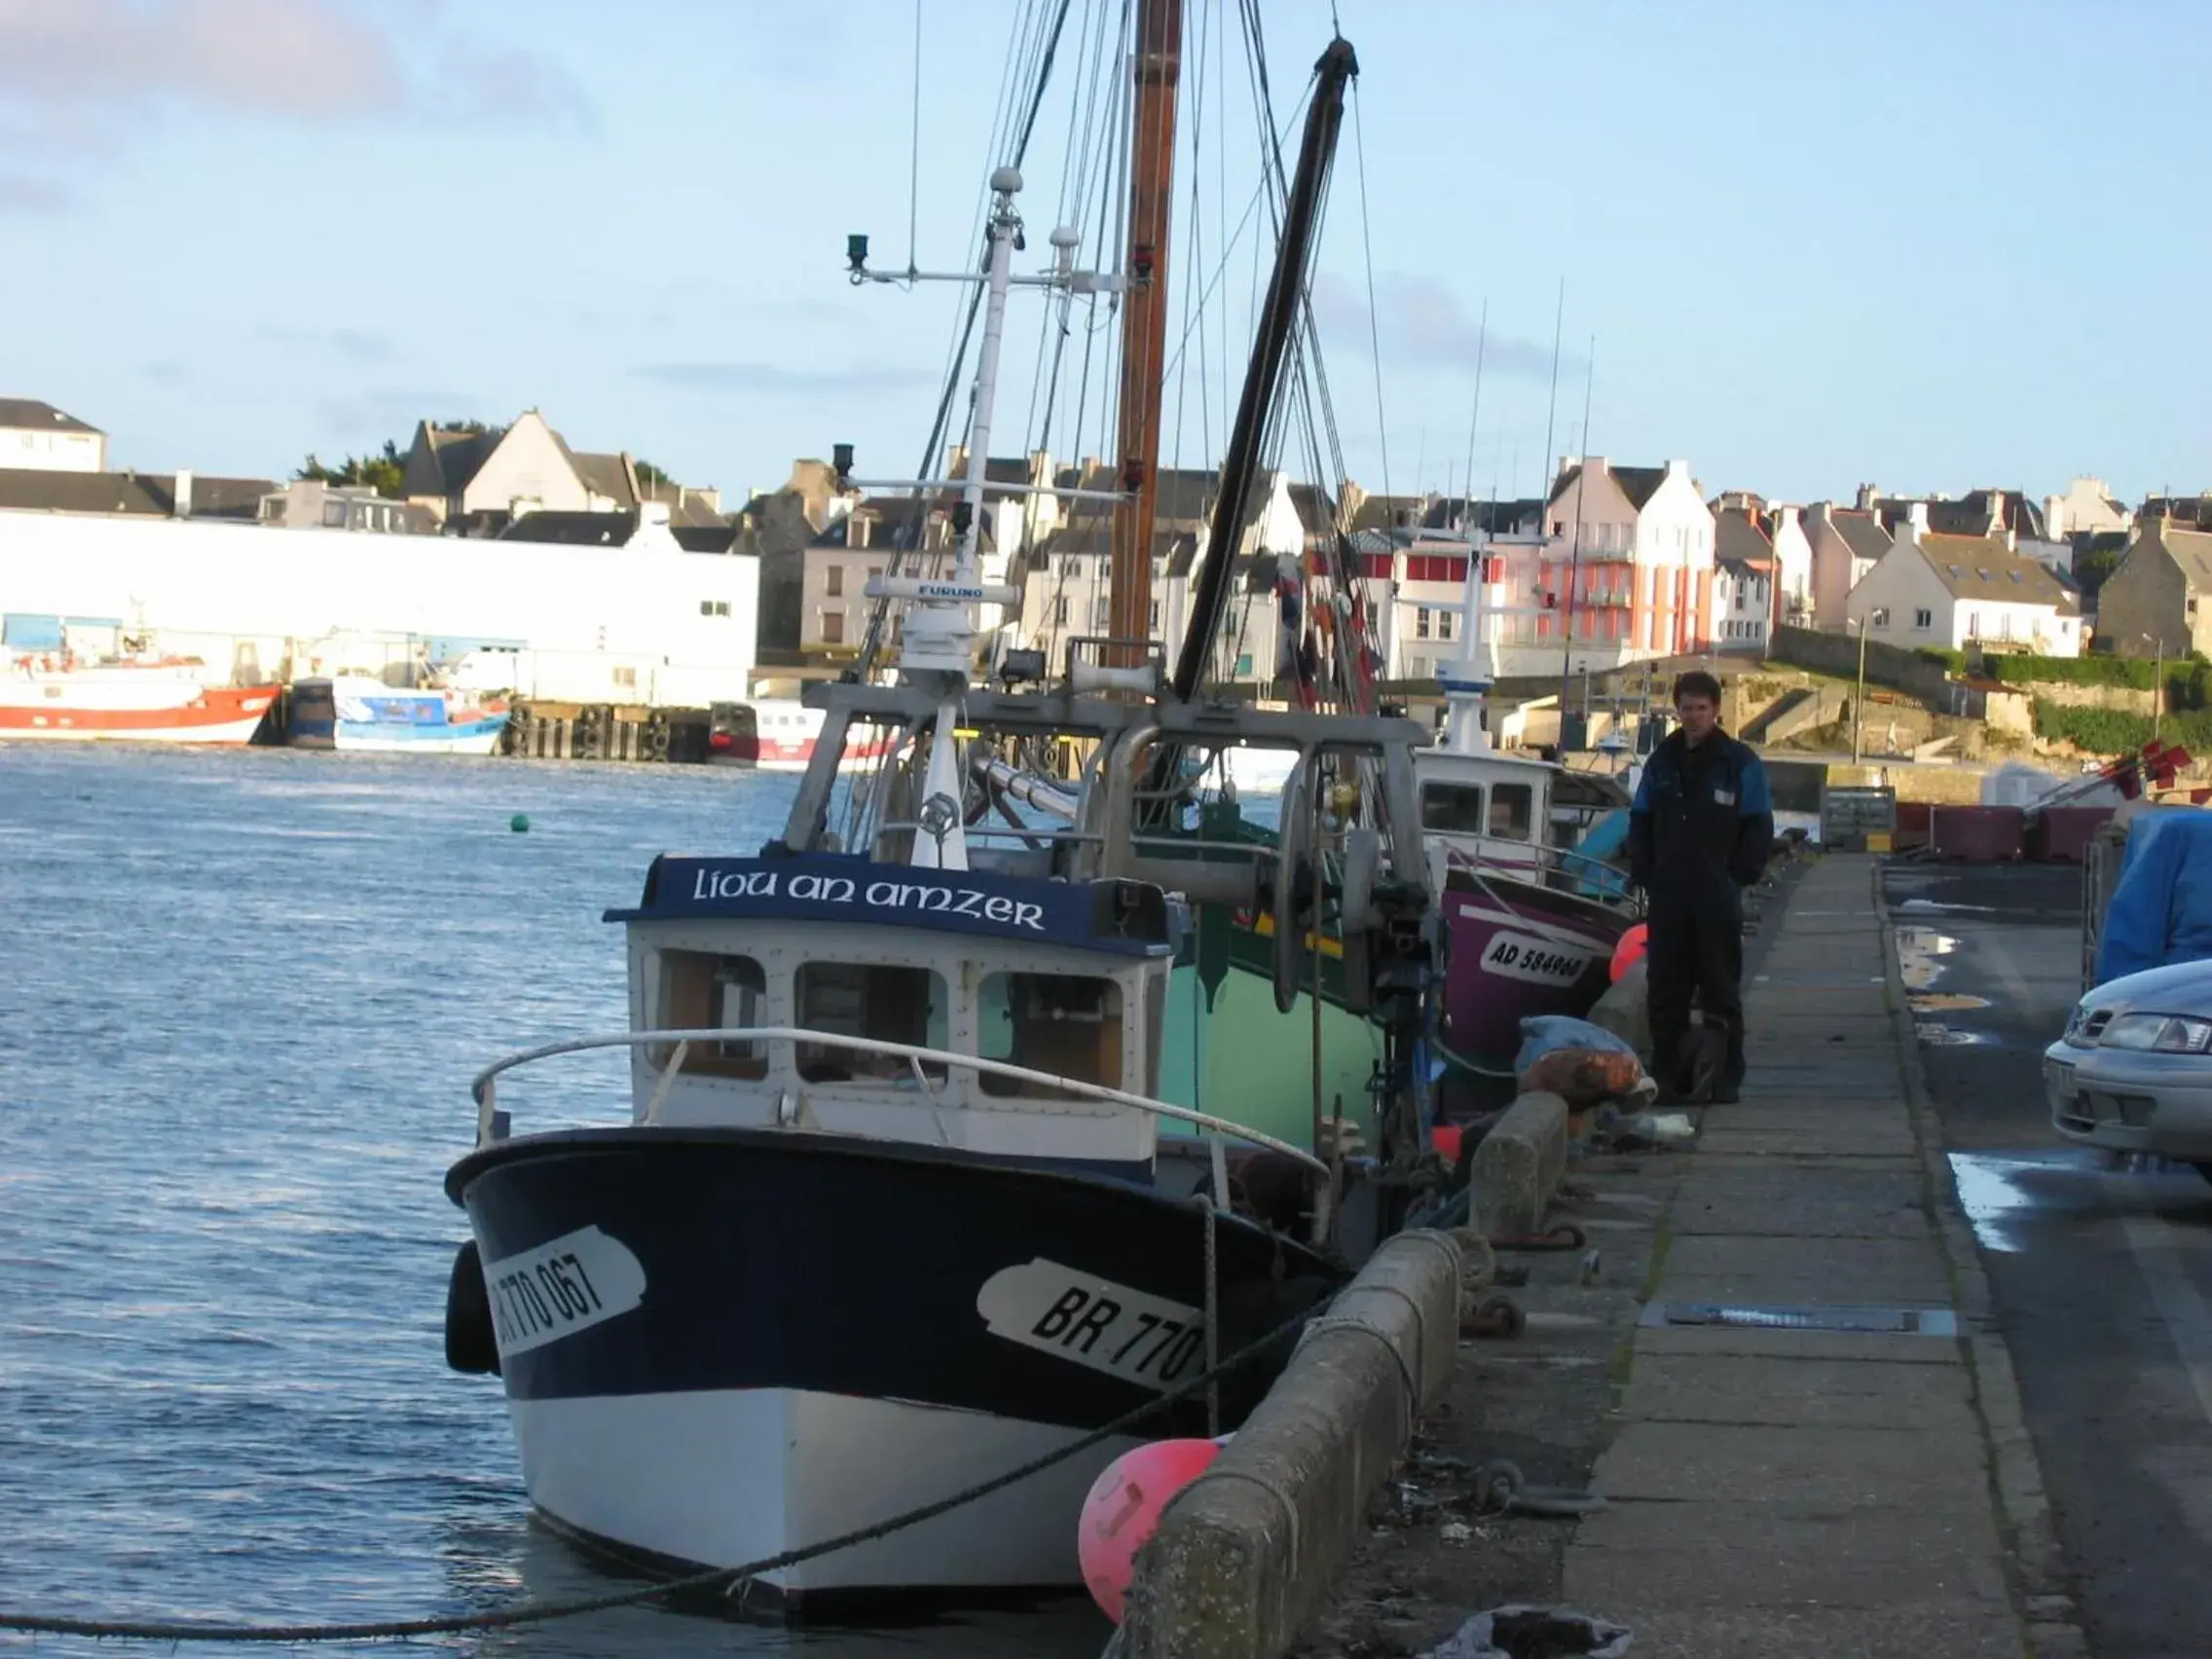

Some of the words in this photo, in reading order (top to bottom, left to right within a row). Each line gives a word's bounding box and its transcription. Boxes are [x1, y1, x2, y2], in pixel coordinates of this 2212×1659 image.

[918, 585, 983, 598] FURUNO
[788, 874, 856, 903] an
[1489, 941, 1519, 966] AD
[498, 1270, 553, 1338] 770
[535, 1253, 604, 1321] 067
[1031, 1286, 1122, 1354] BR
[1109, 1312, 1205, 1382] 770
